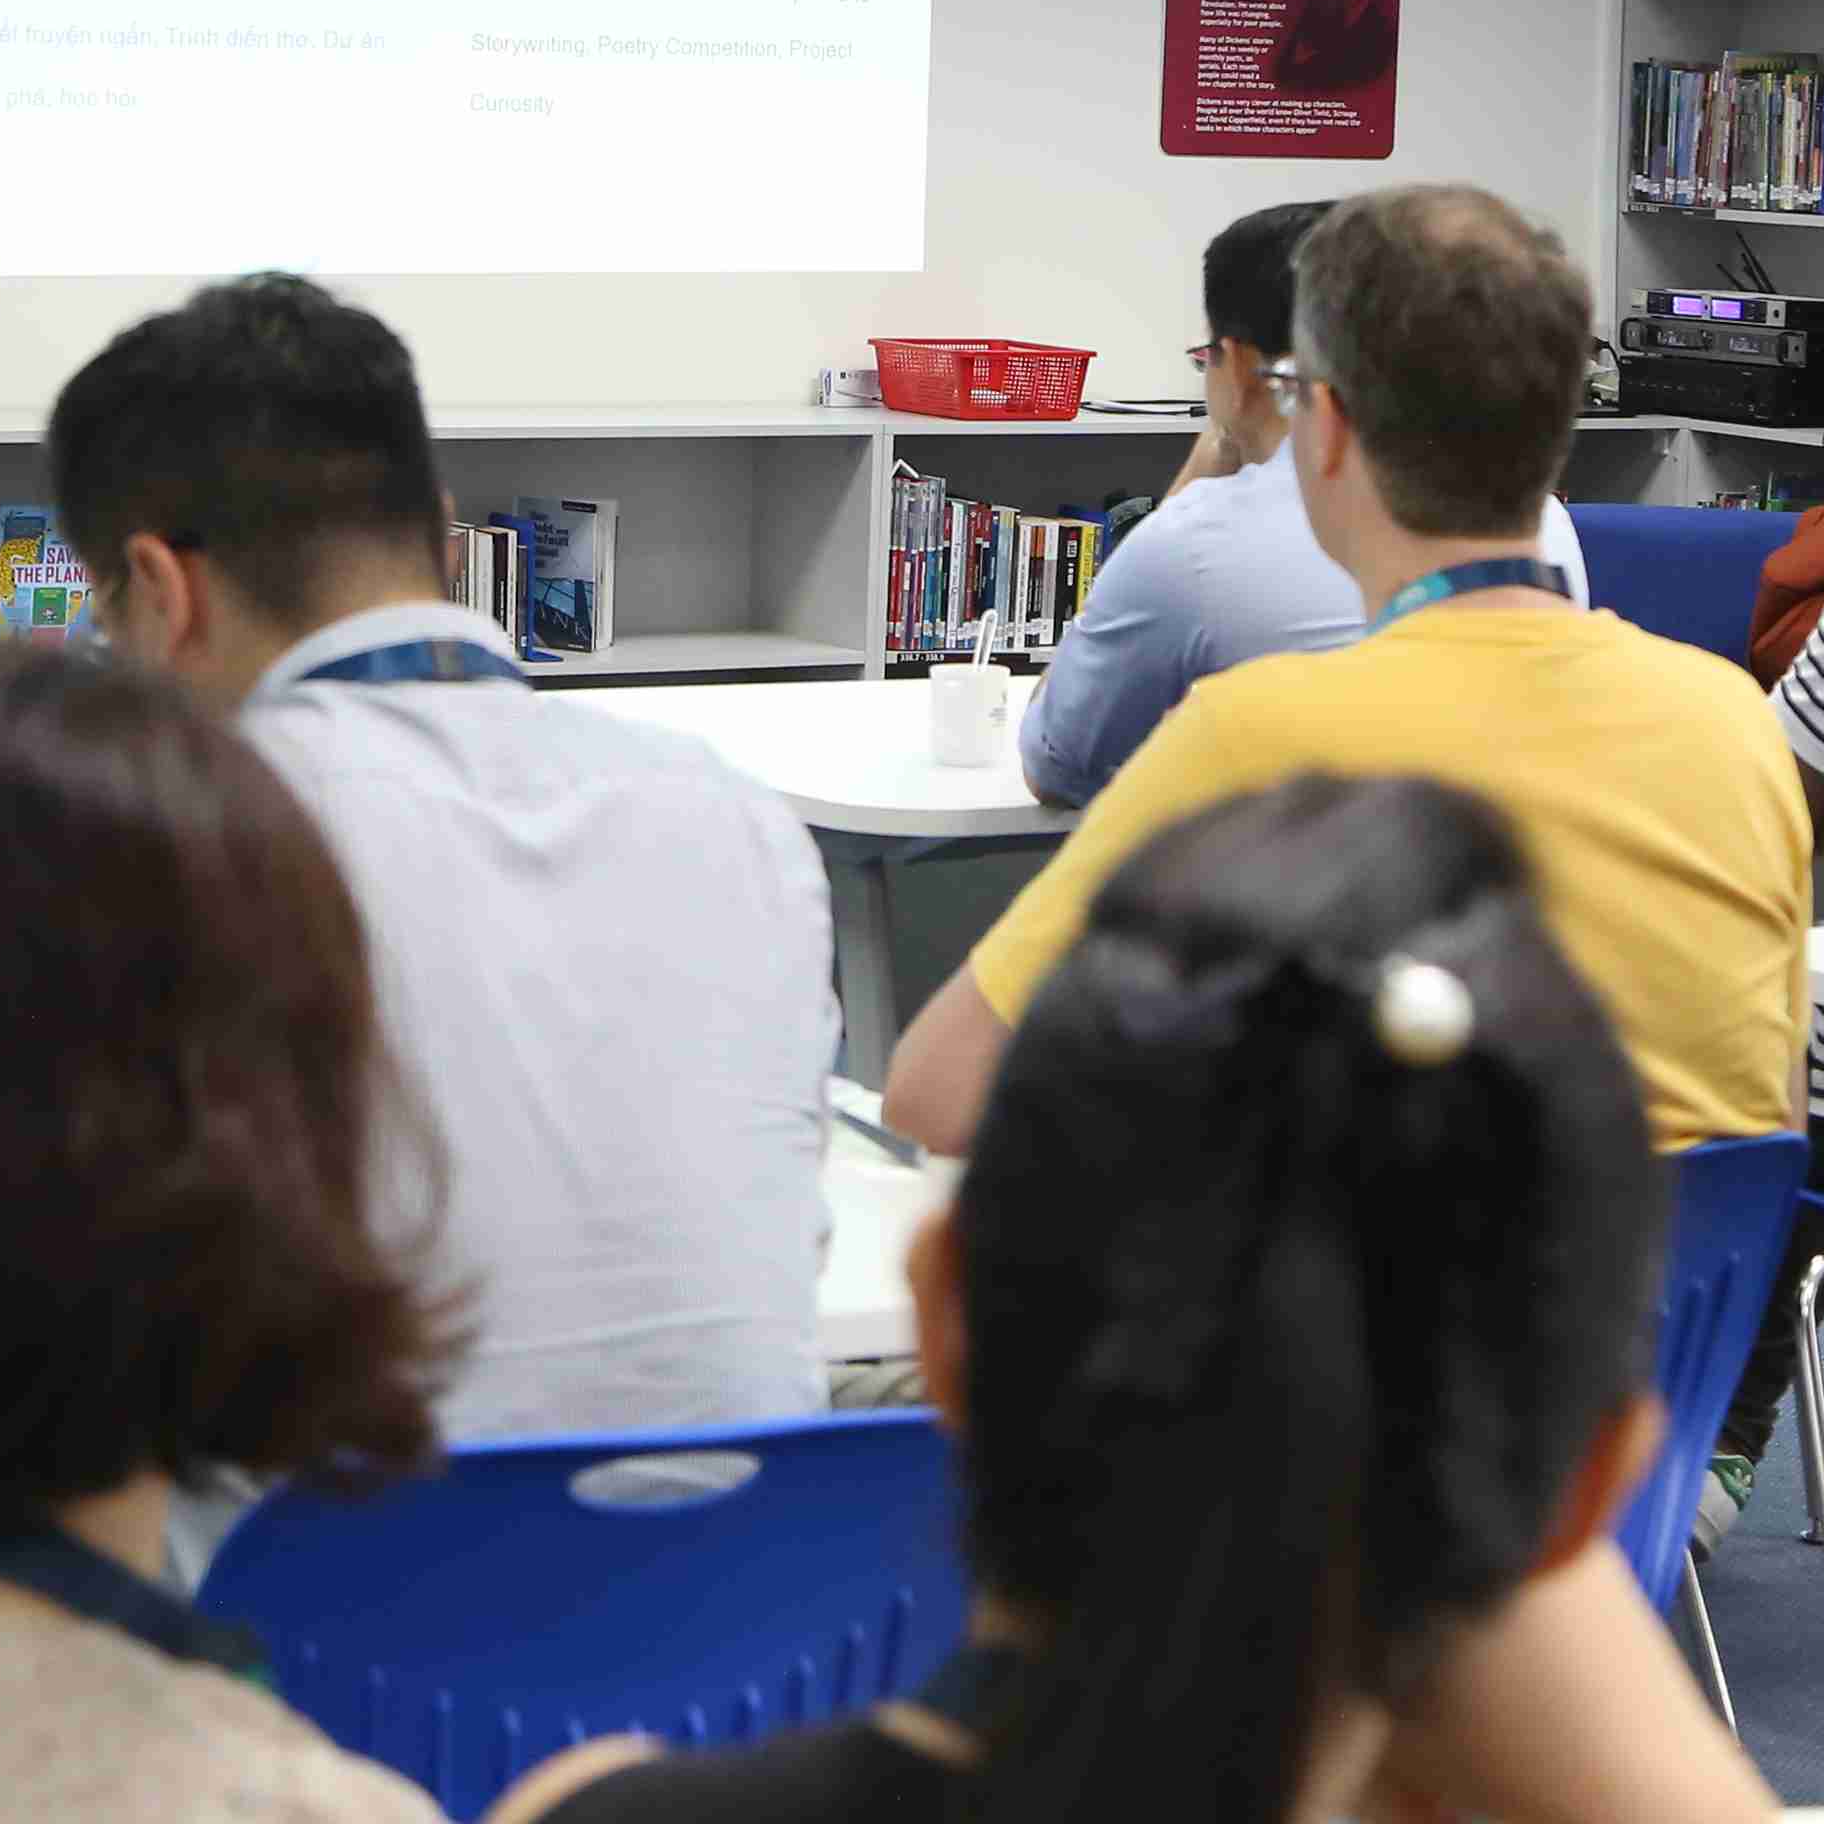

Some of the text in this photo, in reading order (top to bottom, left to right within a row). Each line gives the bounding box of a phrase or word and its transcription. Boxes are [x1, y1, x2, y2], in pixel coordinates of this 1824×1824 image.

[597, 36, 659, 58] Poetry
[789, 40, 854, 62] Project
[16, 566, 43, 583] THE
